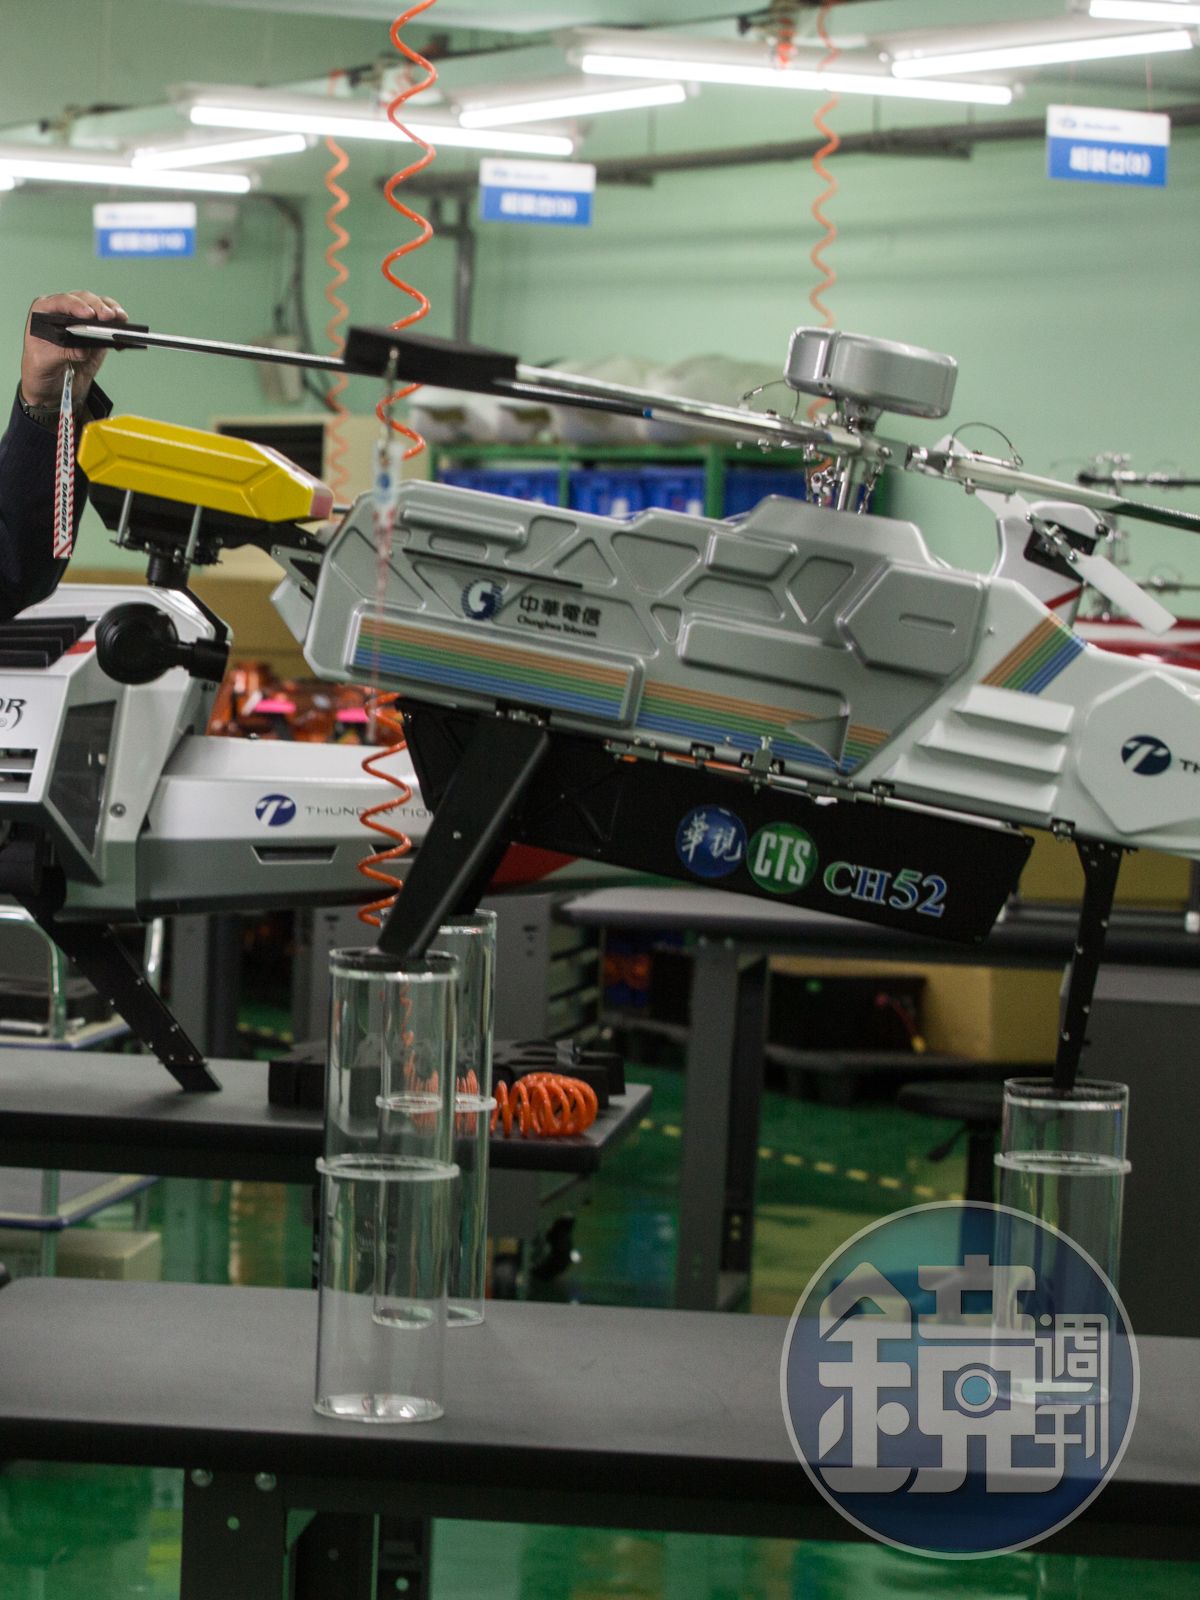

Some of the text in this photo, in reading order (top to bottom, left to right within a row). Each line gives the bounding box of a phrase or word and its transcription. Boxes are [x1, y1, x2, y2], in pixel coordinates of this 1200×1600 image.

[520, 595, 601, 626] 中華電信
[753, 830, 812, 886] CTS
[823, 860, 949, 918] CH52
